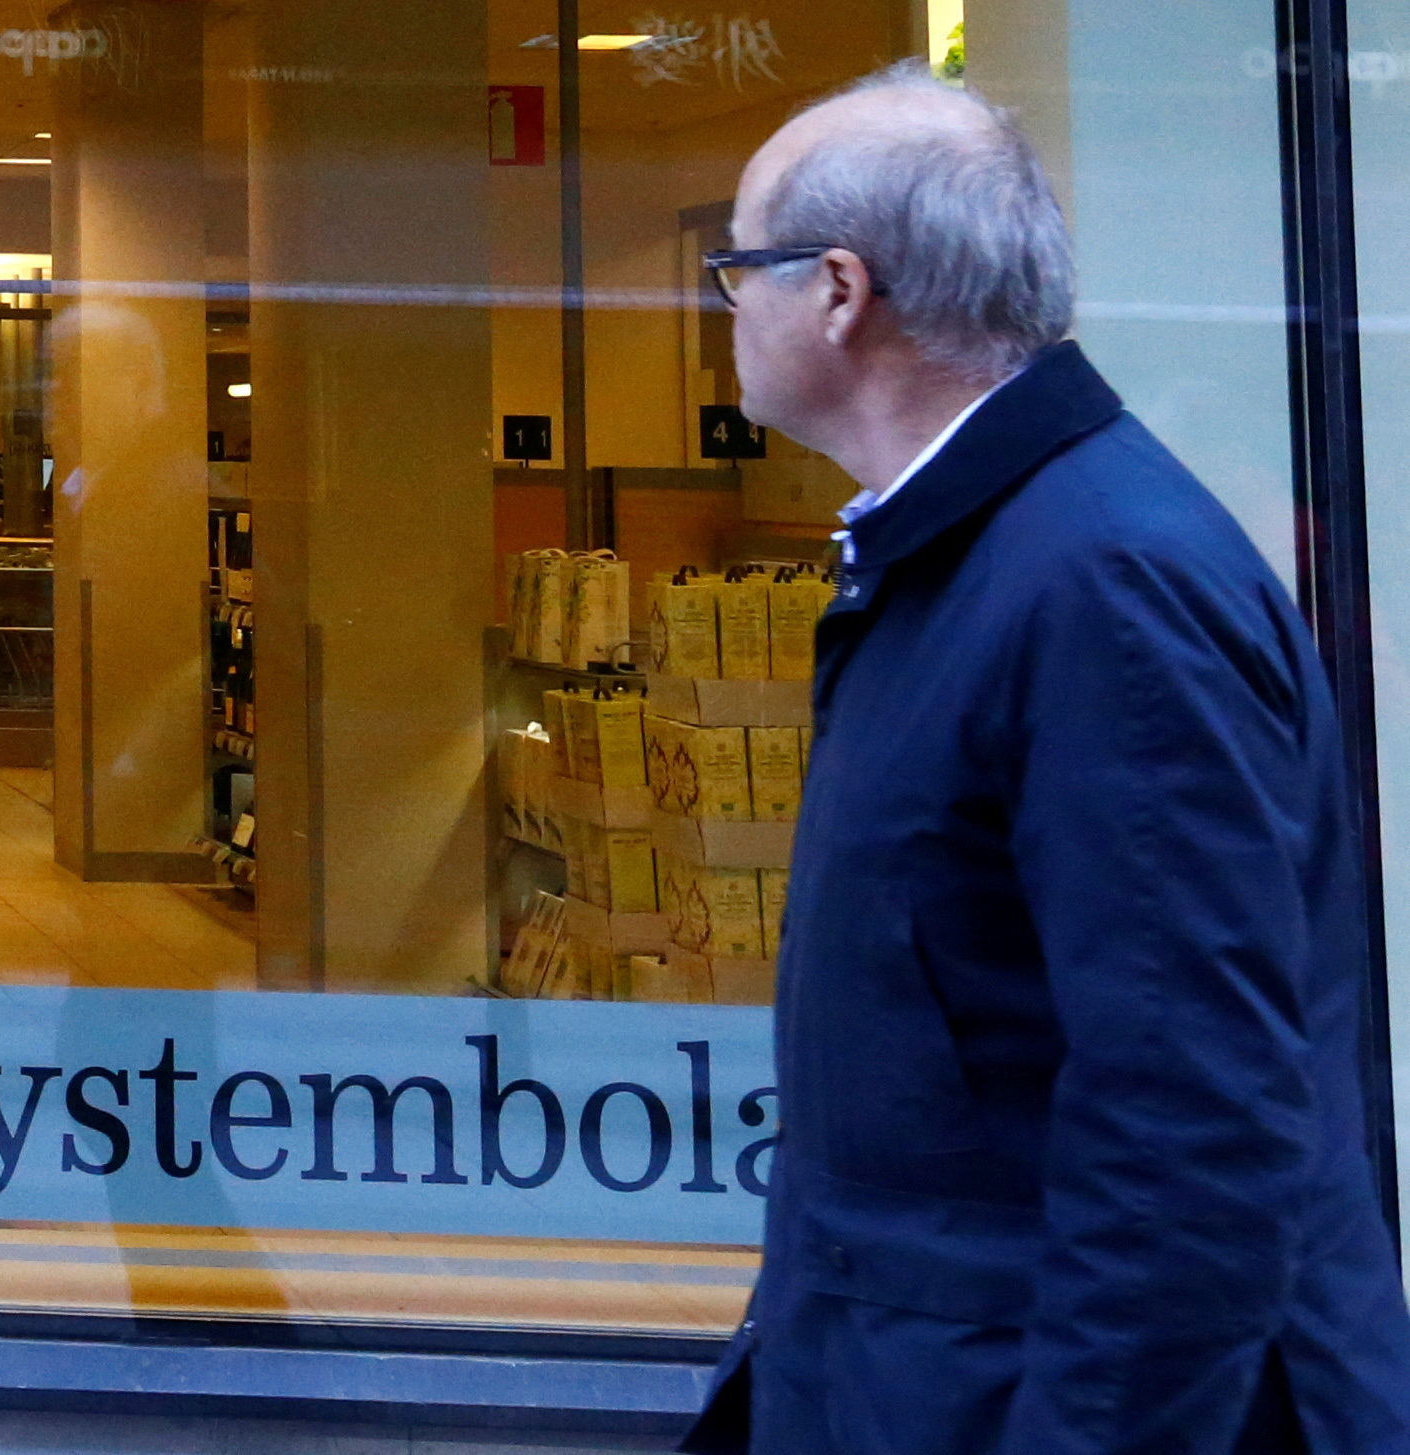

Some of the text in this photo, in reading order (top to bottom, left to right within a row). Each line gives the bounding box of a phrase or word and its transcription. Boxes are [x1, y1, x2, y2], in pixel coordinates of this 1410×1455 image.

[515, 429, 523, 447] 1
[540, 430, 546, 448] 1
[712, 420, 729, 443] 4
